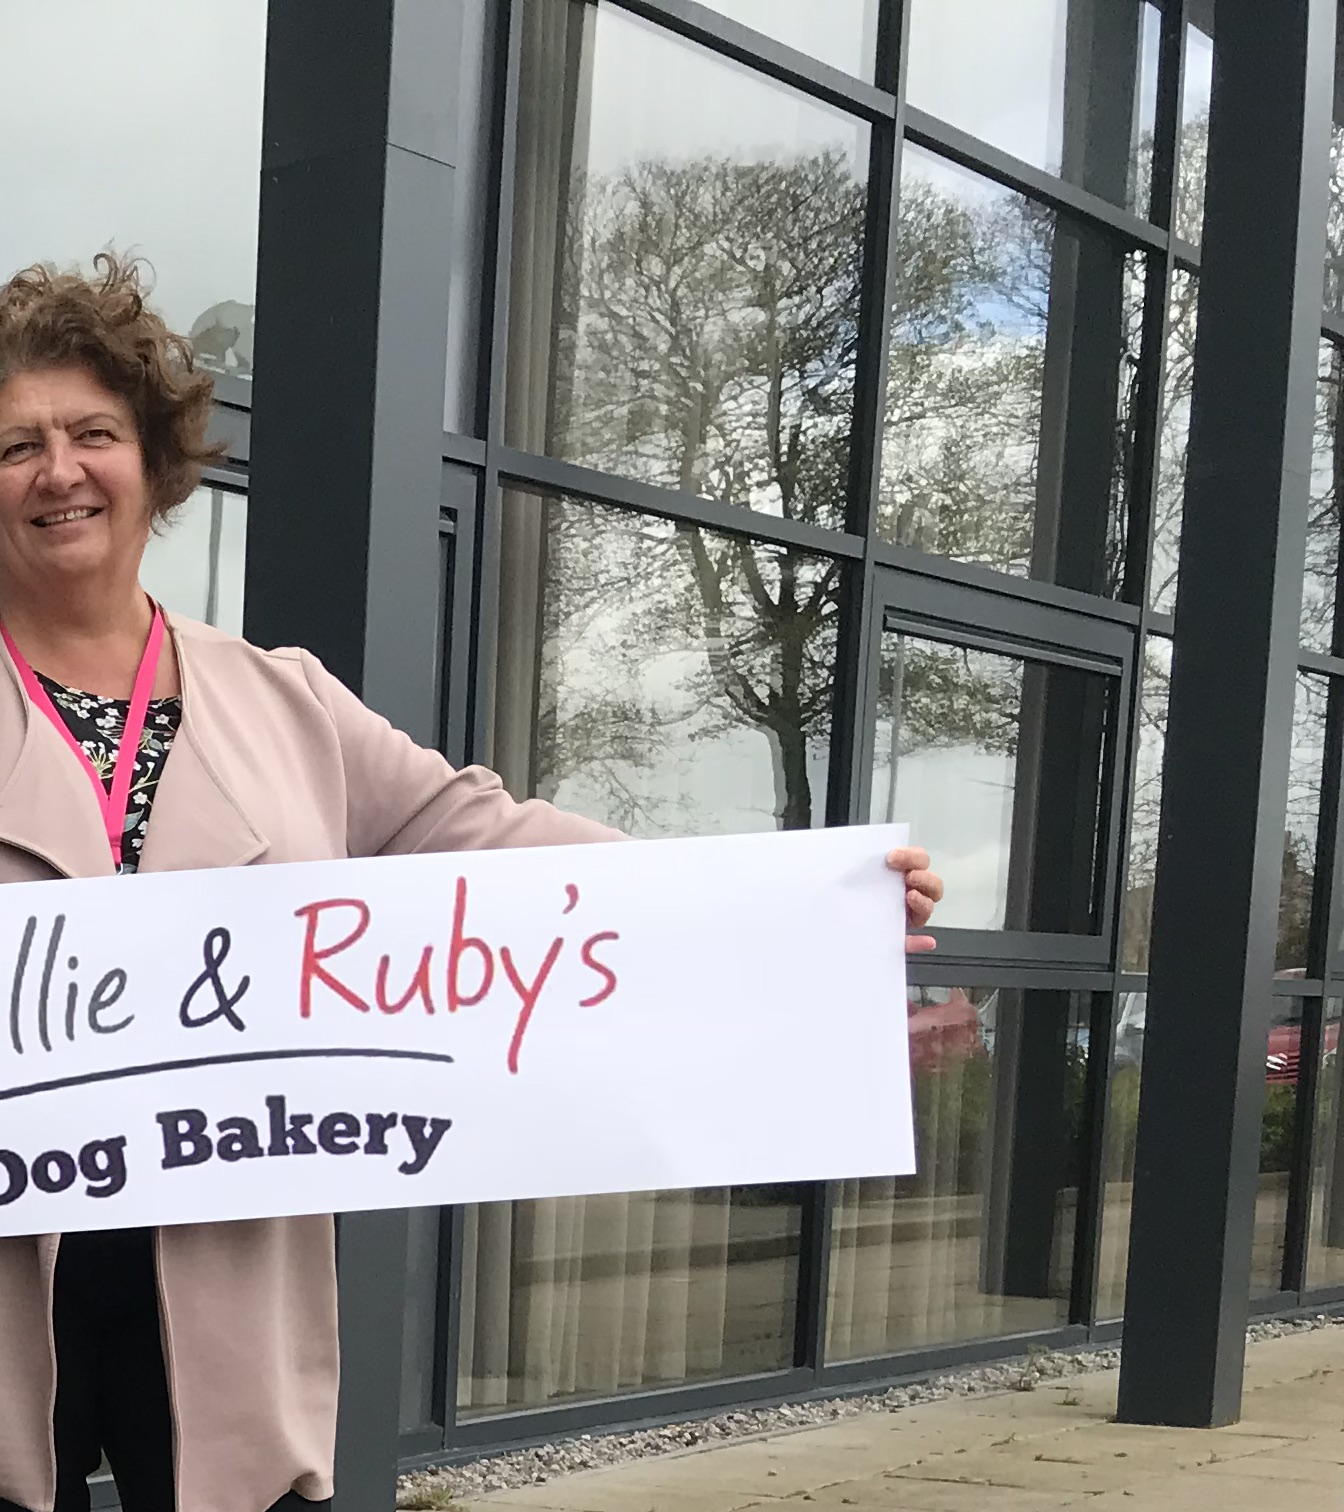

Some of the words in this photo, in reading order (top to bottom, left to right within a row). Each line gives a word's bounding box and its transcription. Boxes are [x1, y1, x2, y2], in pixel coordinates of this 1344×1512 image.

[178, 926, 251, 1033] &
[294, 876, 619, 1074] Ruby's
[155, 1094, 453, 1176] Bakery
